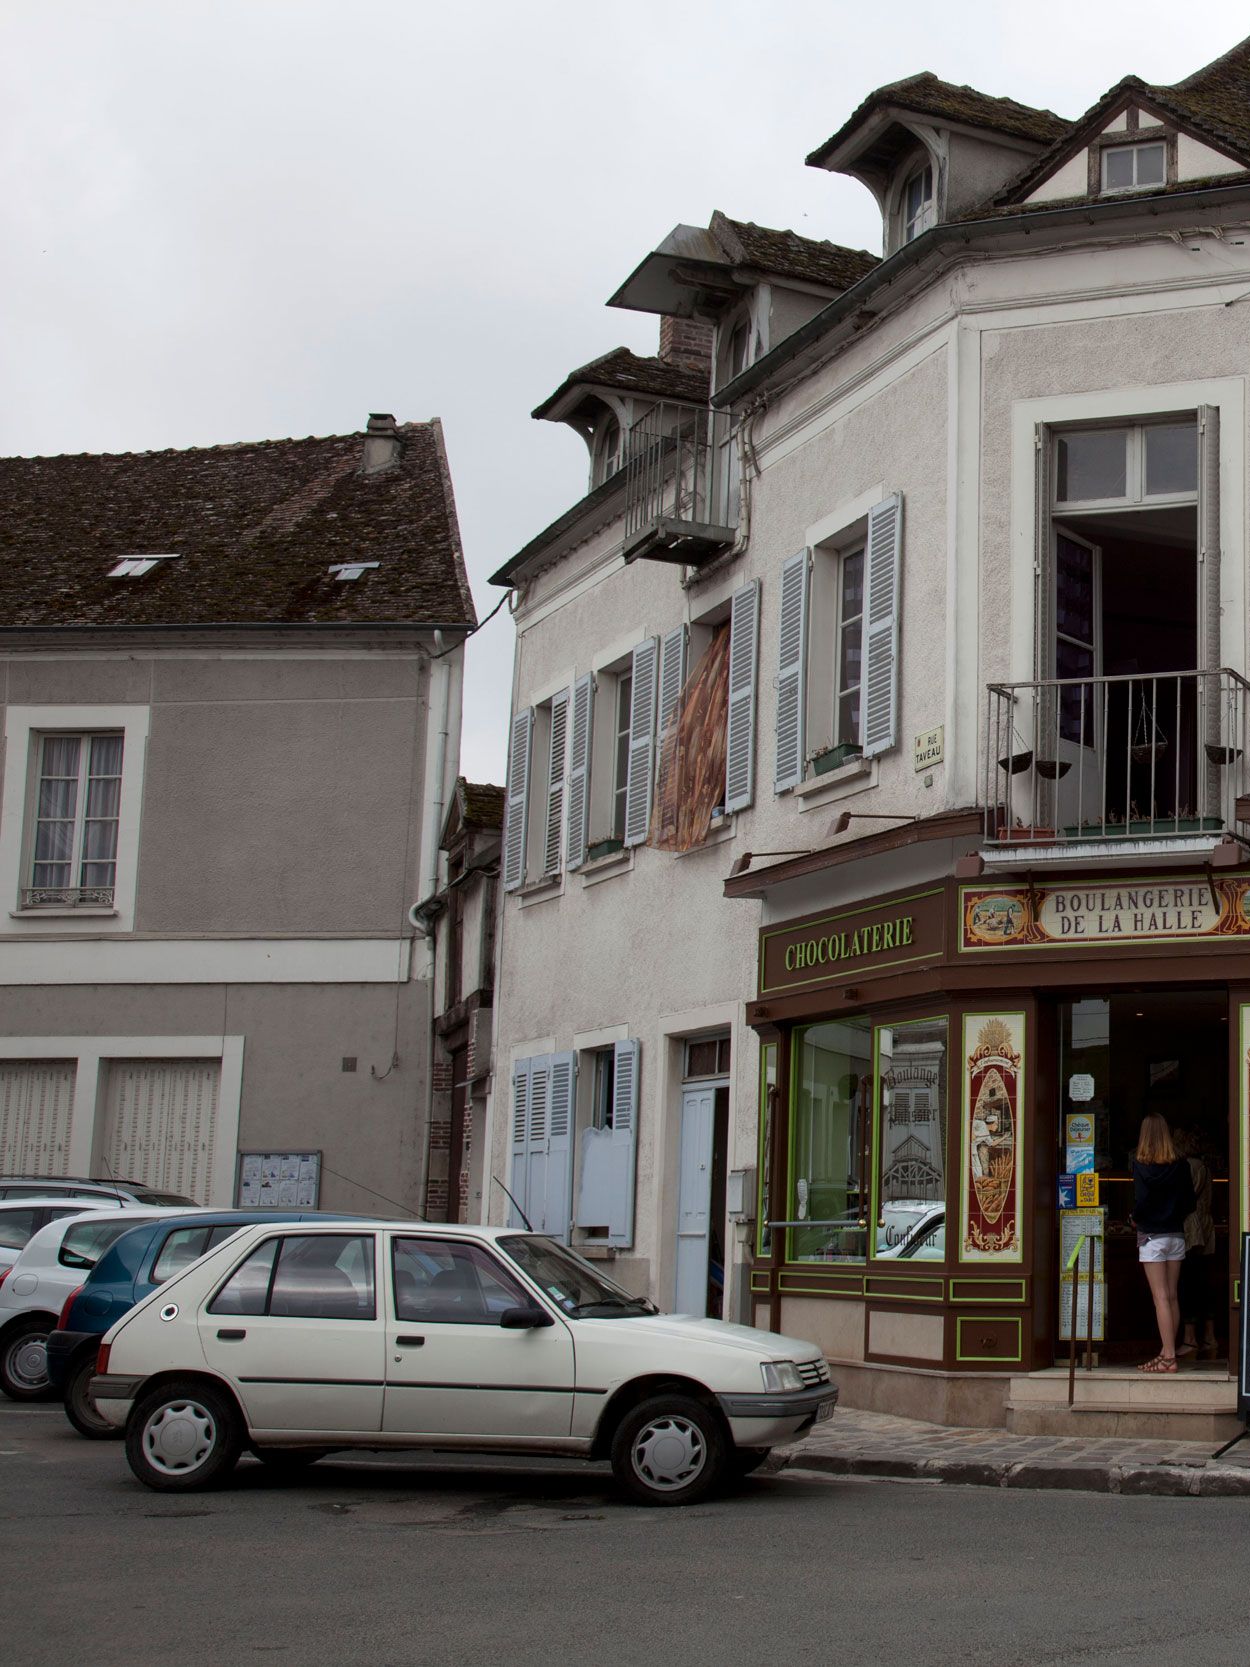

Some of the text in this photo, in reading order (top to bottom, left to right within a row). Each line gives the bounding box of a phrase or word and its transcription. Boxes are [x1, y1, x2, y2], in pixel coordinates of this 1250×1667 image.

[927, 733, 937, 746] RUE
[916, 746, 941, 764] TAVEAU
[1055, 886, 1210, 913] BOULANGERIE
[1061, 910, 1203, 935] DE LA HALLE
[785, 916, 914, 972] CHOCOLATERIE
